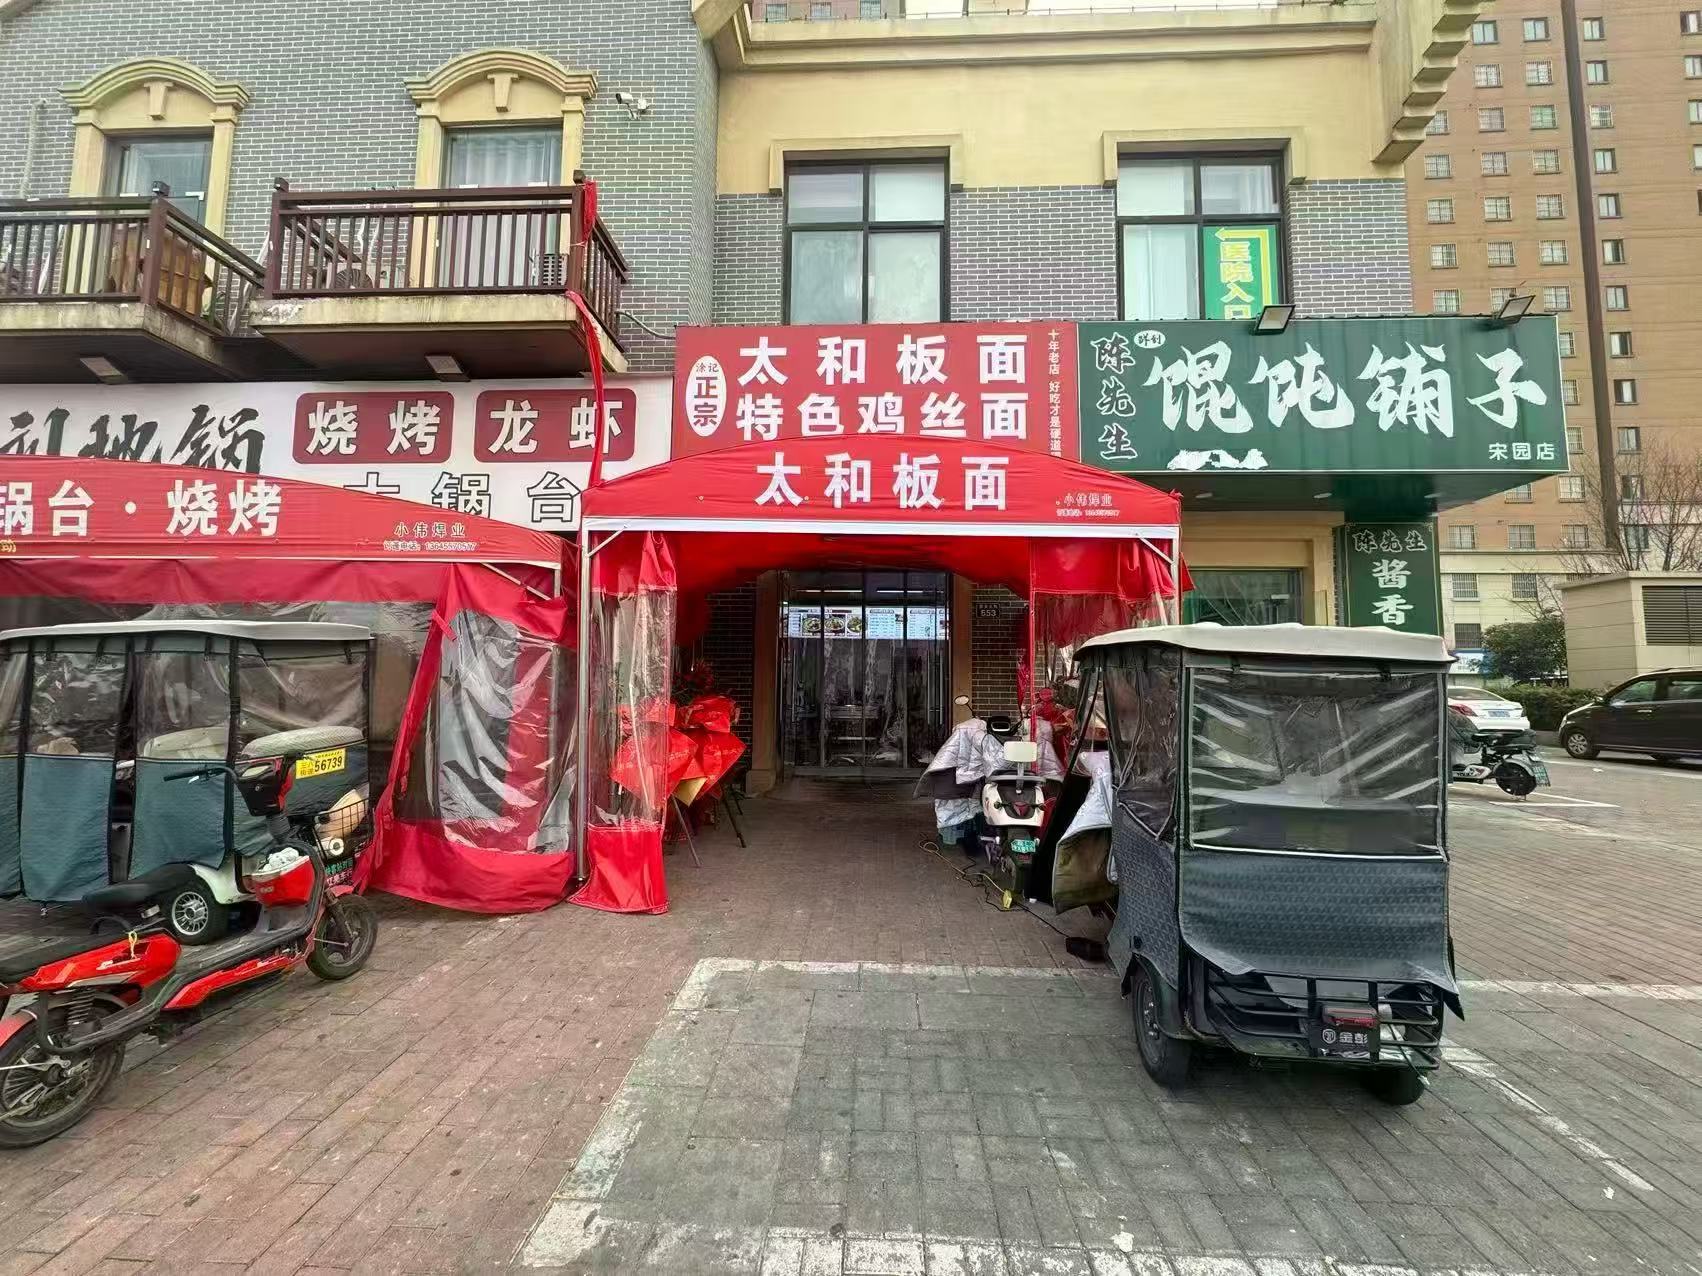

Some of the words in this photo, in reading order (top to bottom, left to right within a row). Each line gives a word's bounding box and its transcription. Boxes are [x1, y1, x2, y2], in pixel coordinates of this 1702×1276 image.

[1220, 241, 1254, 319] 医院入口
[737, 335, 1027, 386] 太和板面
[1047, 329, 1060, 375] 十年老店
[693, 376, 719, 427] 正宗
[1090, 331, 1138, 460] 陈先生
[1142, 341, 1547, 437] 馄饨铺子
[304, 399, 441, 456] 烧烤
[488, 398, 623, 454] 龙虾
[736, 391, 1028, 441] 特色鸡丝面
[1488, 442, 1555, 461] 宋园店
[755, 452, 1009, 511] 太和板面
[393, 521, 466, 538] 小伟焊业
[1352, 529, 1428, 553] 陈先生
[1371, 559, 1415, 625] 酱香
[314, 755, 343, 772] 56739
[1339, 1031, 1368, 1044] 金彭
